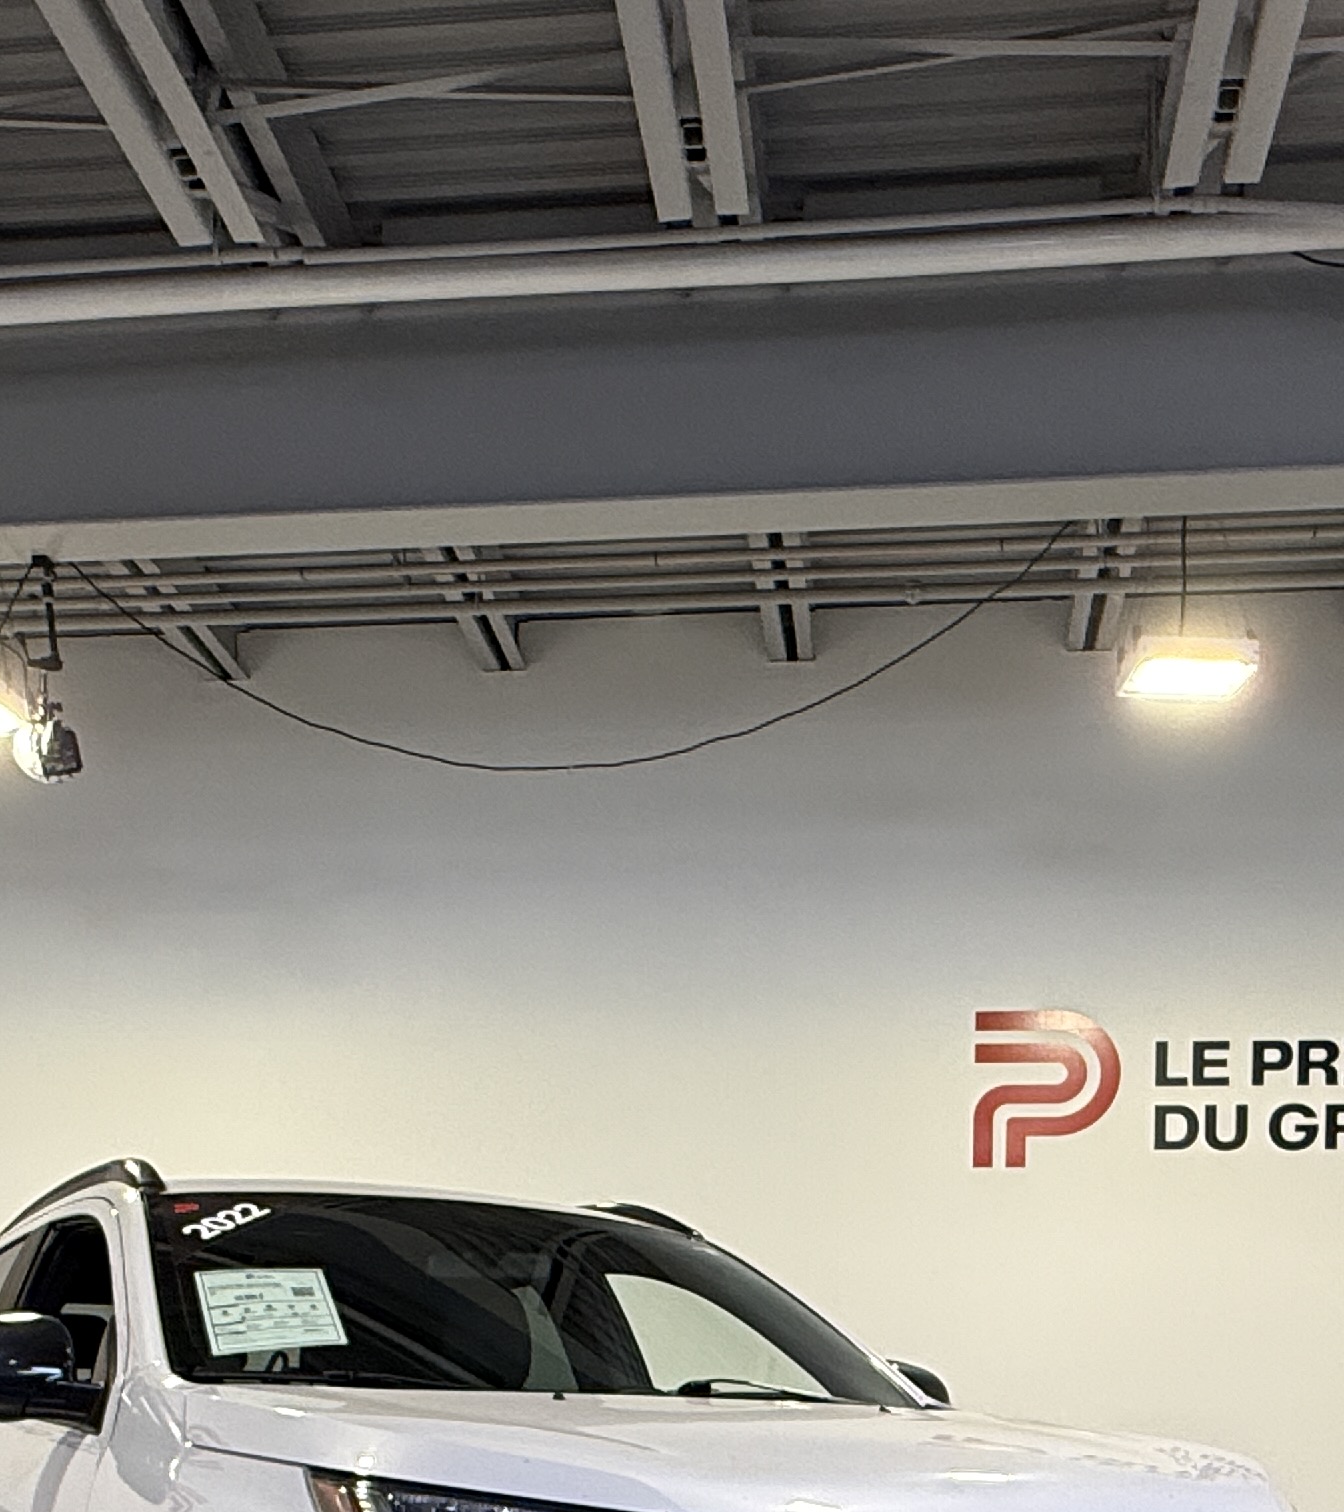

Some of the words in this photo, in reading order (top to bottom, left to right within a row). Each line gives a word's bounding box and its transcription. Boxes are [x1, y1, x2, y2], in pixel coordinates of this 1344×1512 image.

[1155, 1040, 1230, 1087] LE
[1154, 1103, 1248, 1151] DU
[181, 1202, 272, 1241] 2022
